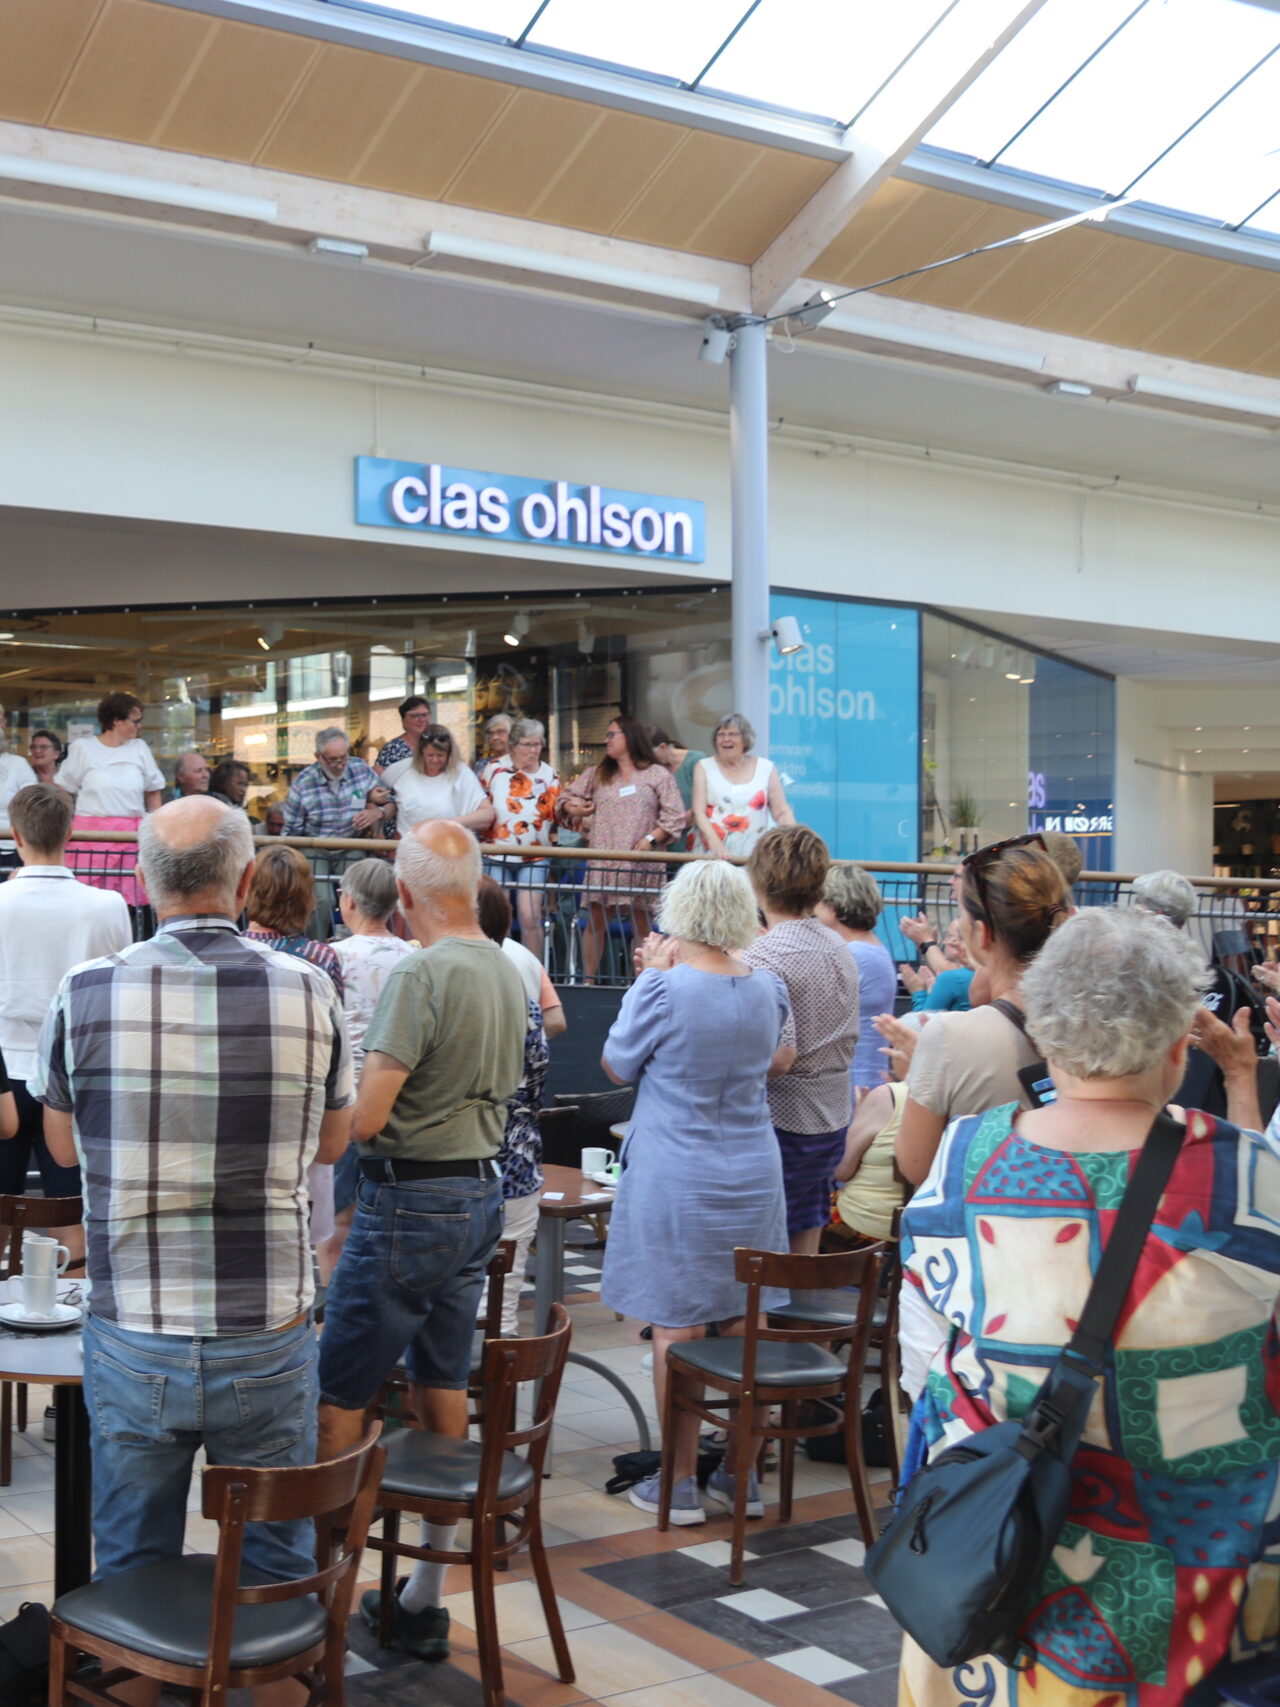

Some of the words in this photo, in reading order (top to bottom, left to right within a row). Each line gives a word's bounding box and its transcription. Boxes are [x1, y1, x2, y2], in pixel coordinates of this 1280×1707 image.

[391, 464, 510, 534] clas
[521, 480, 693, 555] ohlson
[769, 676, 875, 721] ohlson
